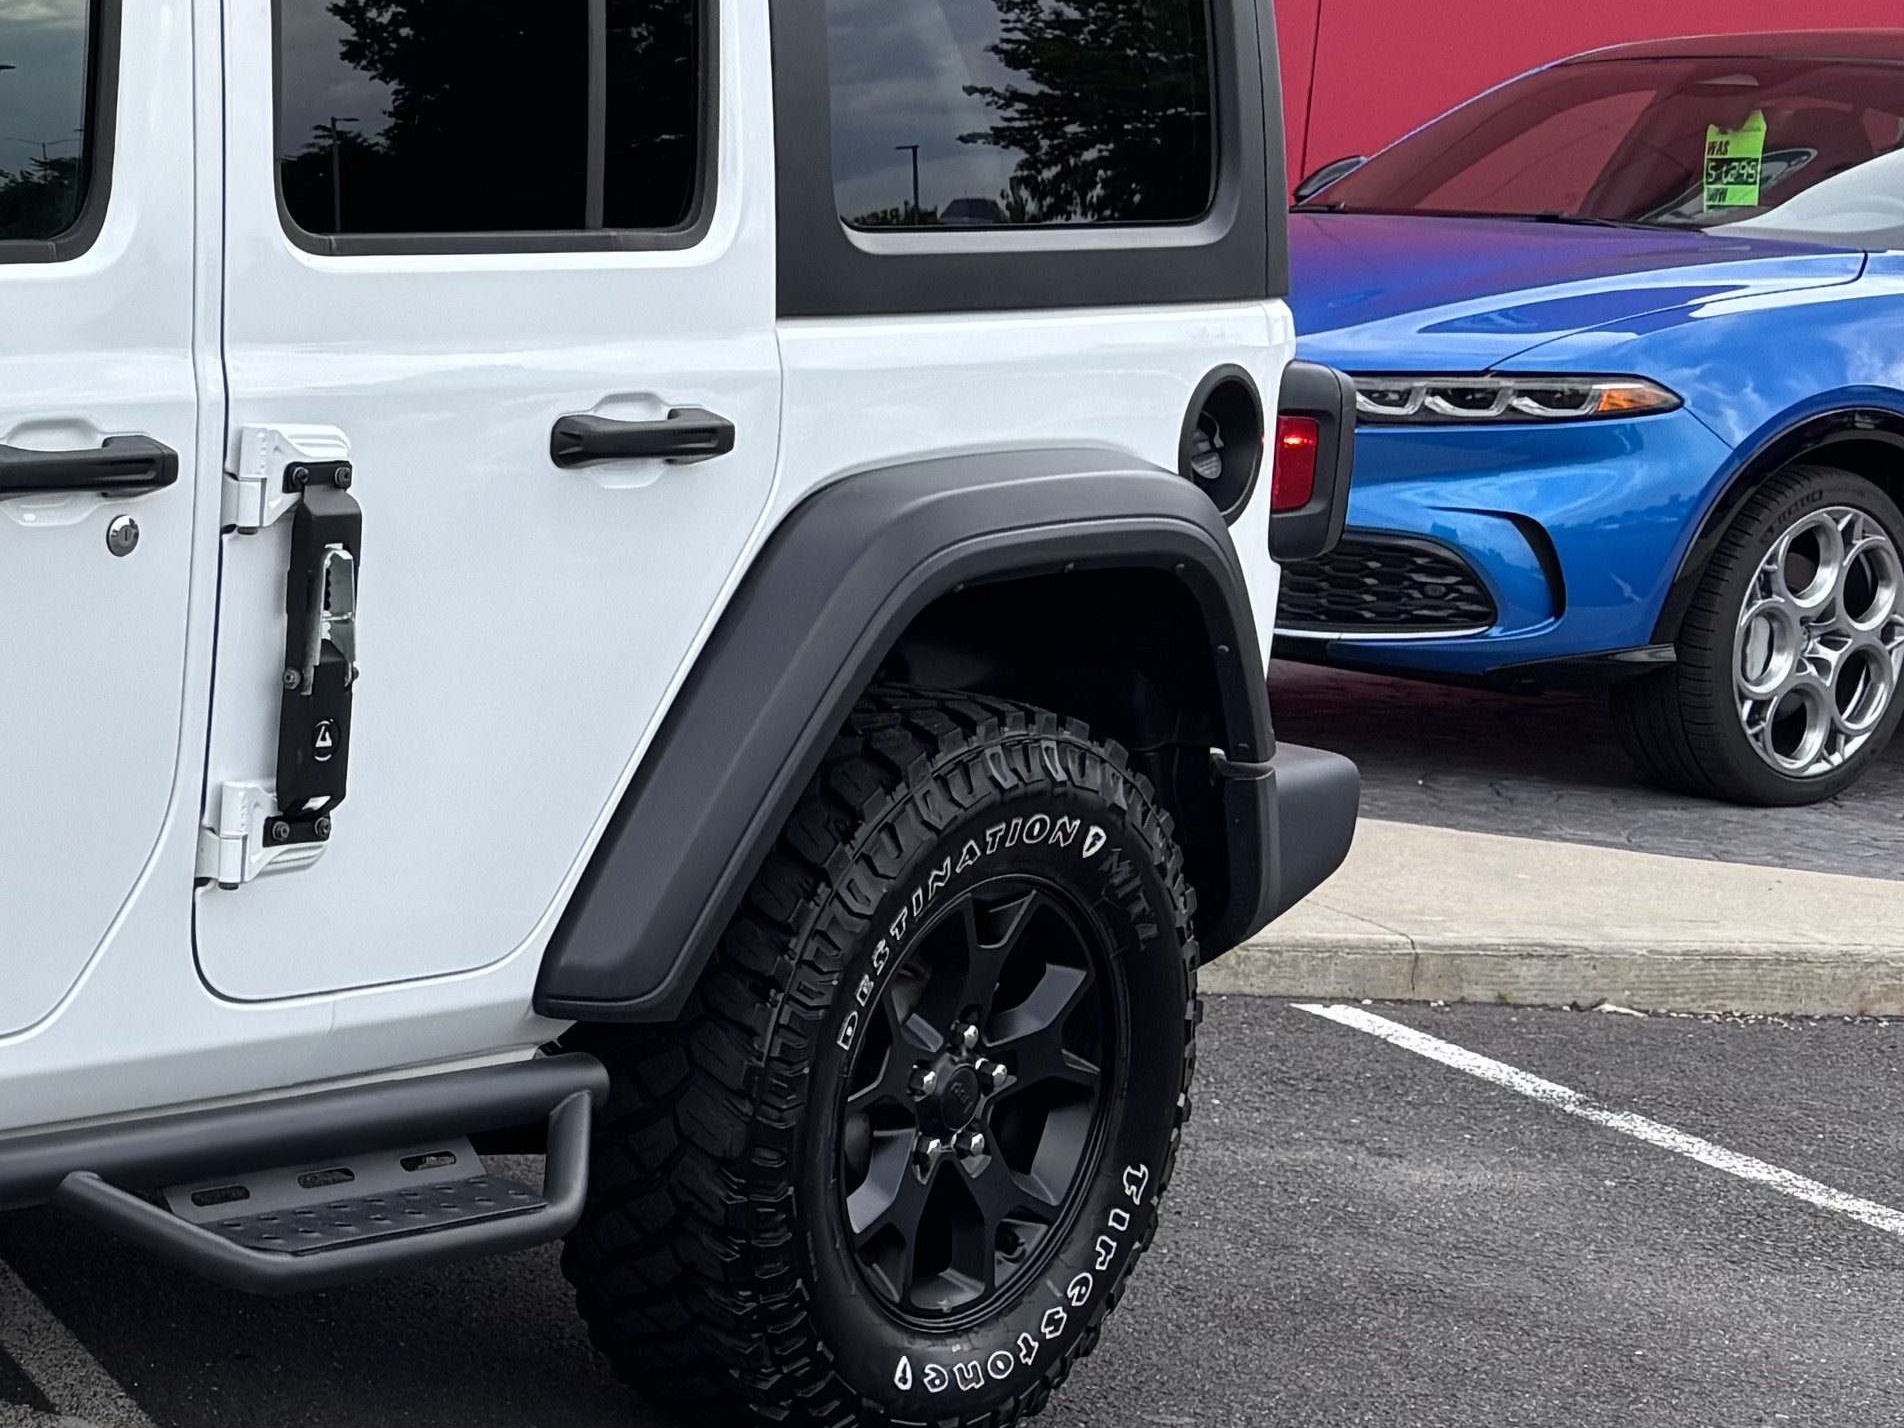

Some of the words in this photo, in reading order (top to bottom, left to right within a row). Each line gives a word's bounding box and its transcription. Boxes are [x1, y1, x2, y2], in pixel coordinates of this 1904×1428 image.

[1707, 139, 1730, 156] WAS
[837, 814, 1081, 1051] DESTINATION
[924, 1164, 1149, 1393] Firestone
